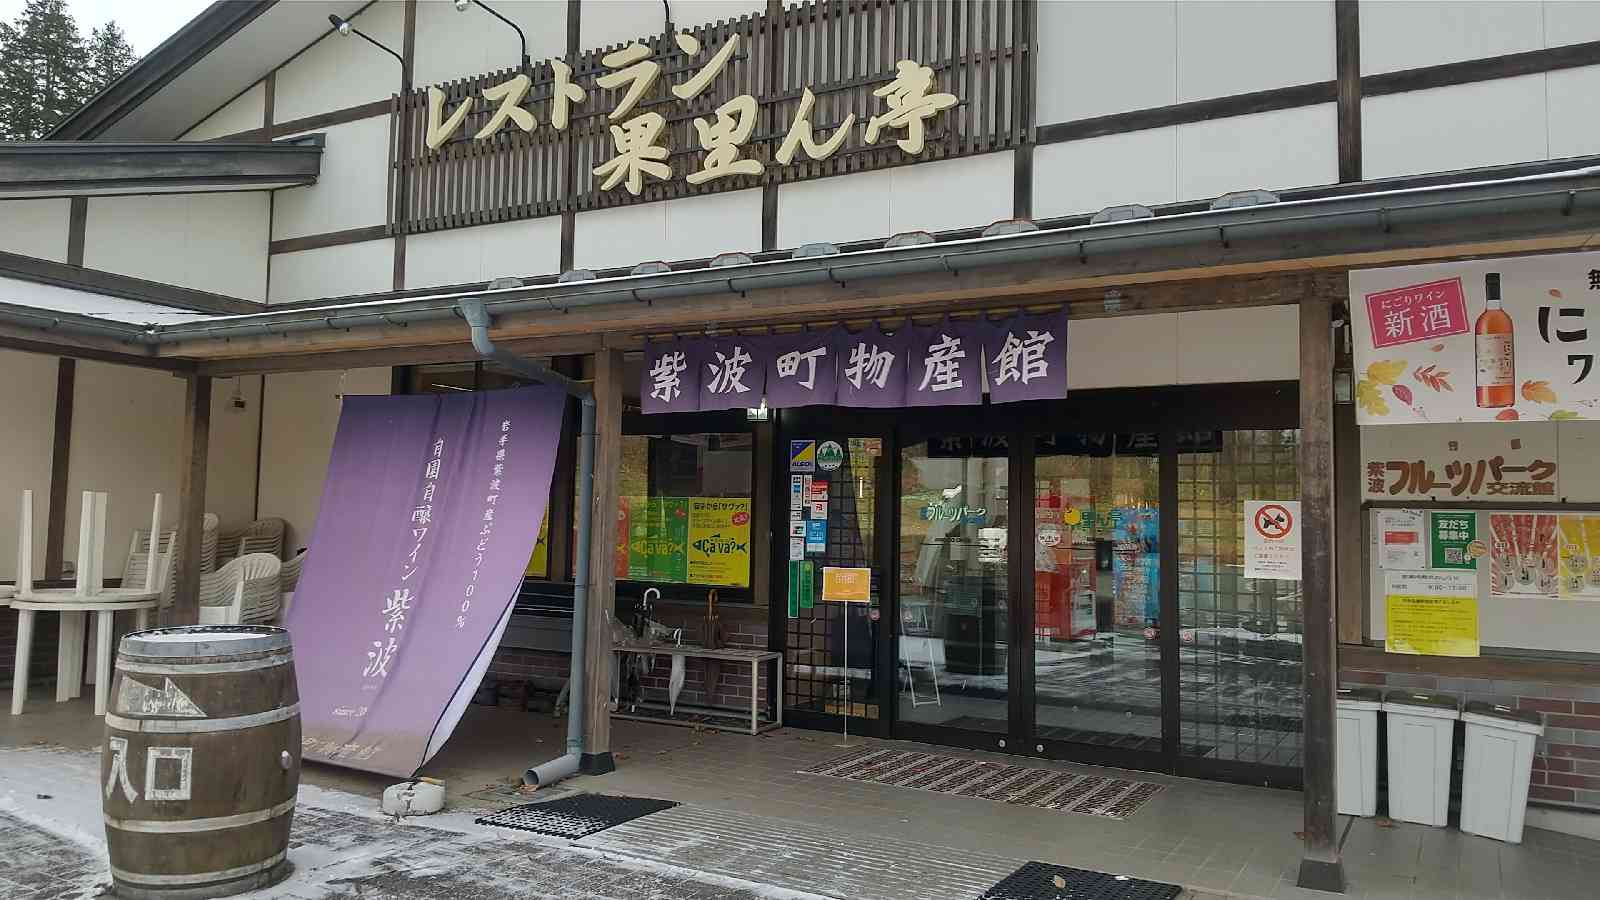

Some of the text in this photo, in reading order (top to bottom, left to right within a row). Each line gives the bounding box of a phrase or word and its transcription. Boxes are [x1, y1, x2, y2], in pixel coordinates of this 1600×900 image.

[426, 33, 740, 150] レストラン
[593, 59, 959, 195] 果里ん亭
[1381, 289, 1445, 309] にごりワイン
[1384, 302, 1452, 338] 新酒
[649, 331, 1055, 402] 紫波町物産館
[1386, 456, 1556, 496] フルーツパーク
[362, 589, 416, 678] 紫波
[106, 736, 192, 803] 入口
